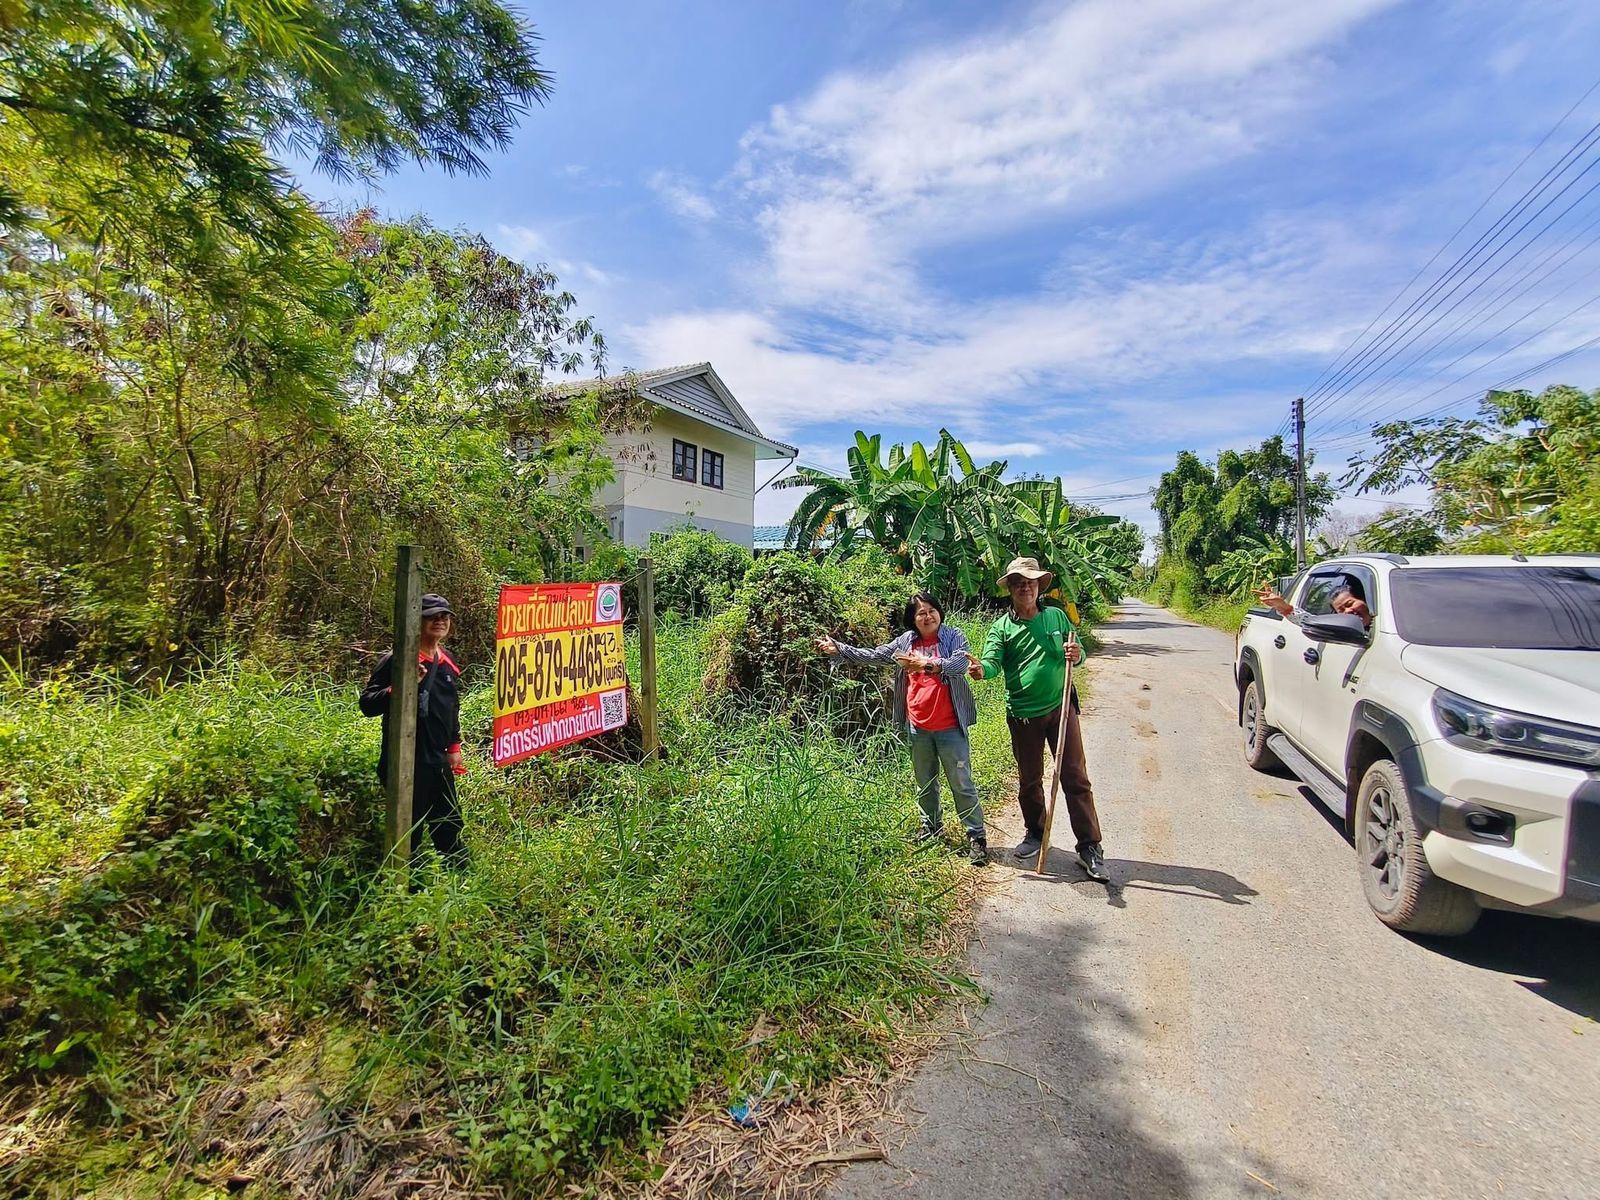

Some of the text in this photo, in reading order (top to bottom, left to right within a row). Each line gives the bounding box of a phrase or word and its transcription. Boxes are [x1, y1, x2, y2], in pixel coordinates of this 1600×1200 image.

[501, 583, 597, 635] ขายที่ดินแปลงนี้
[497, 633, 602, 711] 095-879-4465
[495, 700, 602, 761] บริการรับฝากขายที่ดิน
